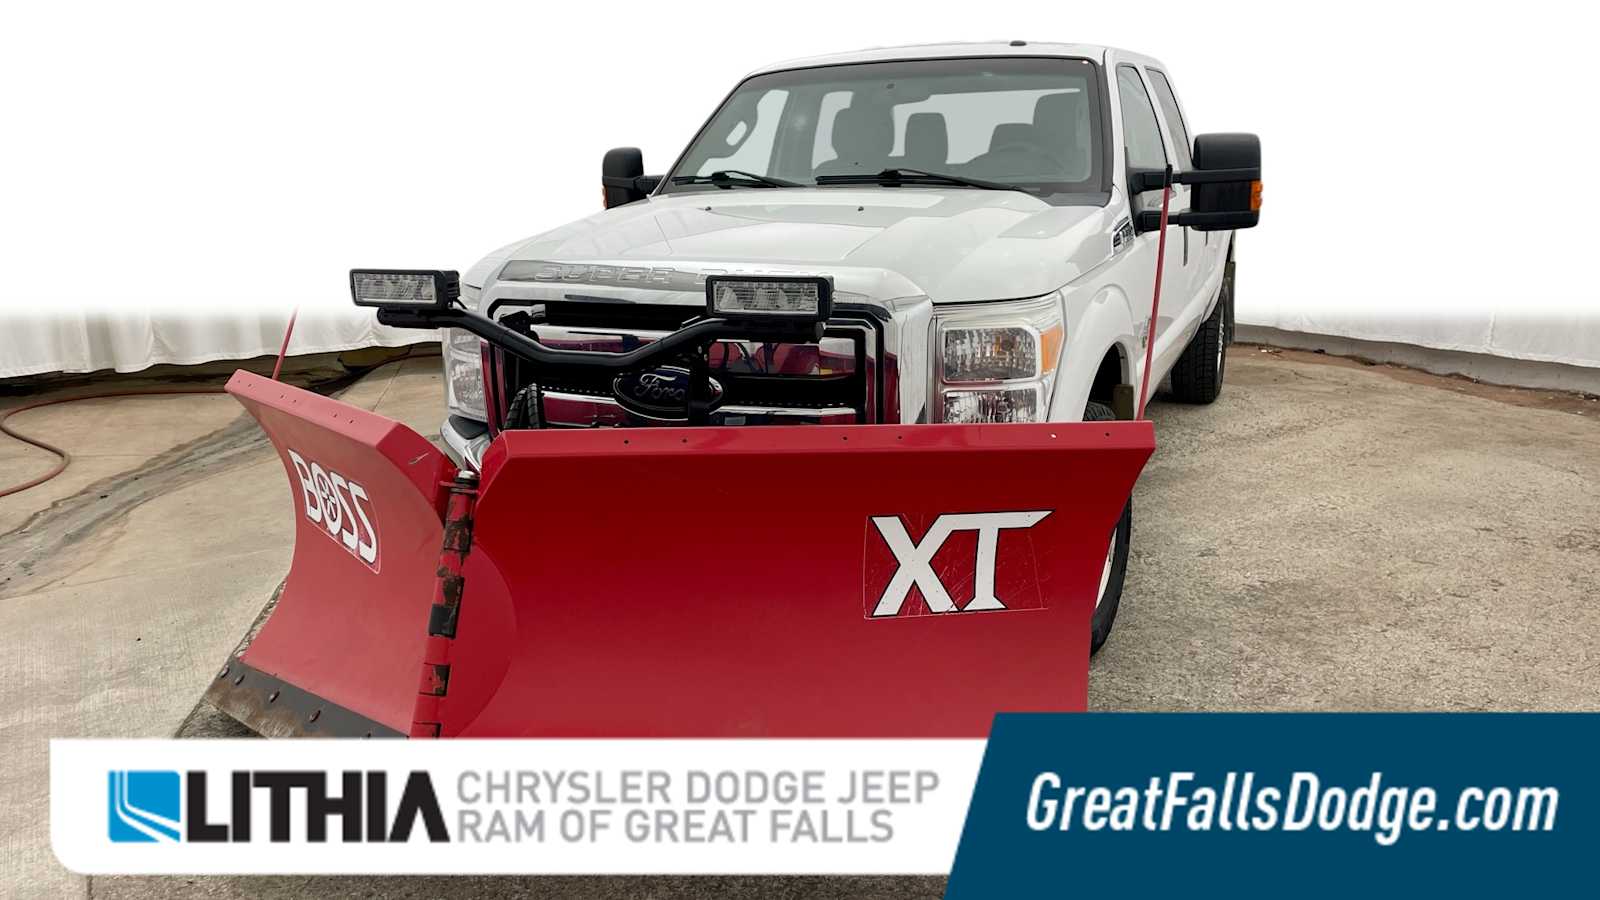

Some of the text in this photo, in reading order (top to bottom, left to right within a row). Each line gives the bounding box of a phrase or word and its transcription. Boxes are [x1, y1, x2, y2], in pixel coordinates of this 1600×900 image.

[534, 263, 677, 284] SUPER
[288, 449, 378, 563] BOSS
[871, 509, 1056, 617] XT
